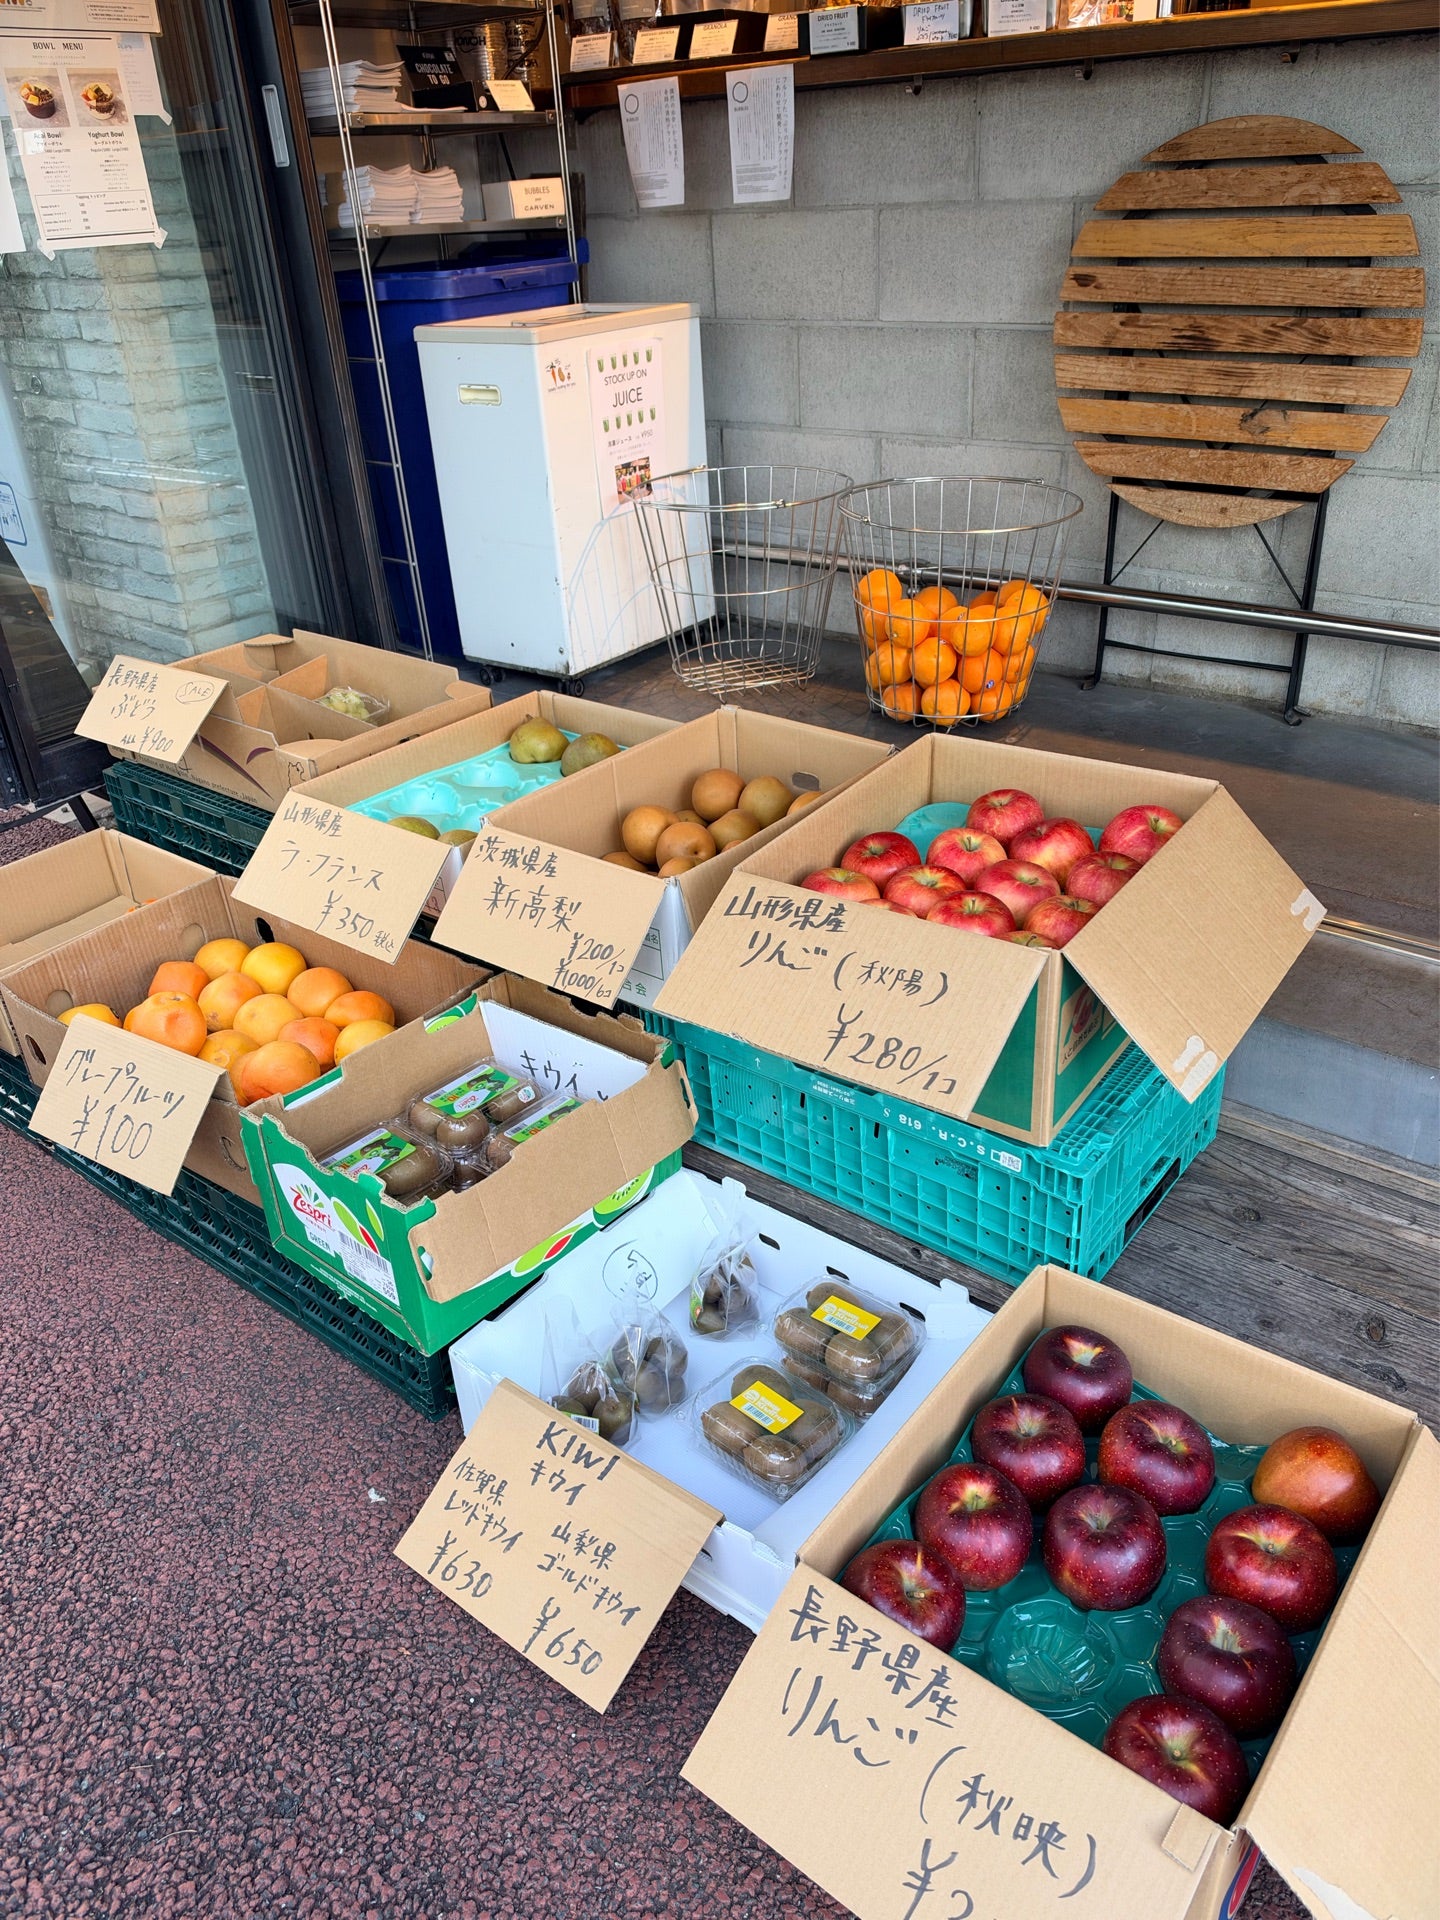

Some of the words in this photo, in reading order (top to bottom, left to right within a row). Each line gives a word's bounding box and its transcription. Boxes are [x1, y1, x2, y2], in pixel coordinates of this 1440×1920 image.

[703, 22, 728, 31] GRANOLA
[817, 14, 833, 22] DRIED
[834, 11, 849, 20] FRUIT
[32, 42, 55, 50] BOWL
[62, 42, 84, 51] MENU
[415, 63, 454, 74] CHOCOLATE
[427, 74, 439, 85] TO
[439, 75, 450, 85] GO
[47, 131, 62, 139] Bowl
[88, 131, 109, 140] Yoghurt
[524, 186, 551, 195] BUBBLES
[524, 204, 555, 212] CARVEN
[604, 373, 626, 386] STOCK
[626, 370, 636, 382] UP
[636, 368, 648, 379] ON
[612, 386, 644, 408] JUICE
[107, 663, 159, 694] 長野県産
[179, 681, 212, 698] SALE
[110, 693, 157, 720] ぶどう
[138, 726, 174, 753] ¥900
[283, 801, 344, 838] 山形県産
[281, 840, 384, 891] ラ・フランス
[475, 835, 560, 878] 茨城県産
[315, 890, 375, 938] ¥350
[373, 930, 396, 954] 税込
[483, 875, 583, 933] 新高梨
[723, 886, 849, 934] 山形県産
[64, 1048, 186, 1120] グレープフルーツ
[70, 1094, 154, 1161] ¥100
[898, 1113, 923, 1131] 618
[289, 1185, 332, 1228] Zespri
[309, 1231, 331, 1252] GREEN
[535, 1420, 622, 1483] KIWI
[453, 1456, 508, 1508] 佐賀県
[529, 1459, 589, 1506] キウイ
[443, 1488, 525, 1554] レッドキウイ
[427, 1529, 494, 1600] ¥630
[551, 1521, 619, 1572] 山梨県
[522, 1596, 605, 1677] ¥650
[789, 1584, 961, 1730] 長野県産
[902, 1838, 997, 1920] ¥2
